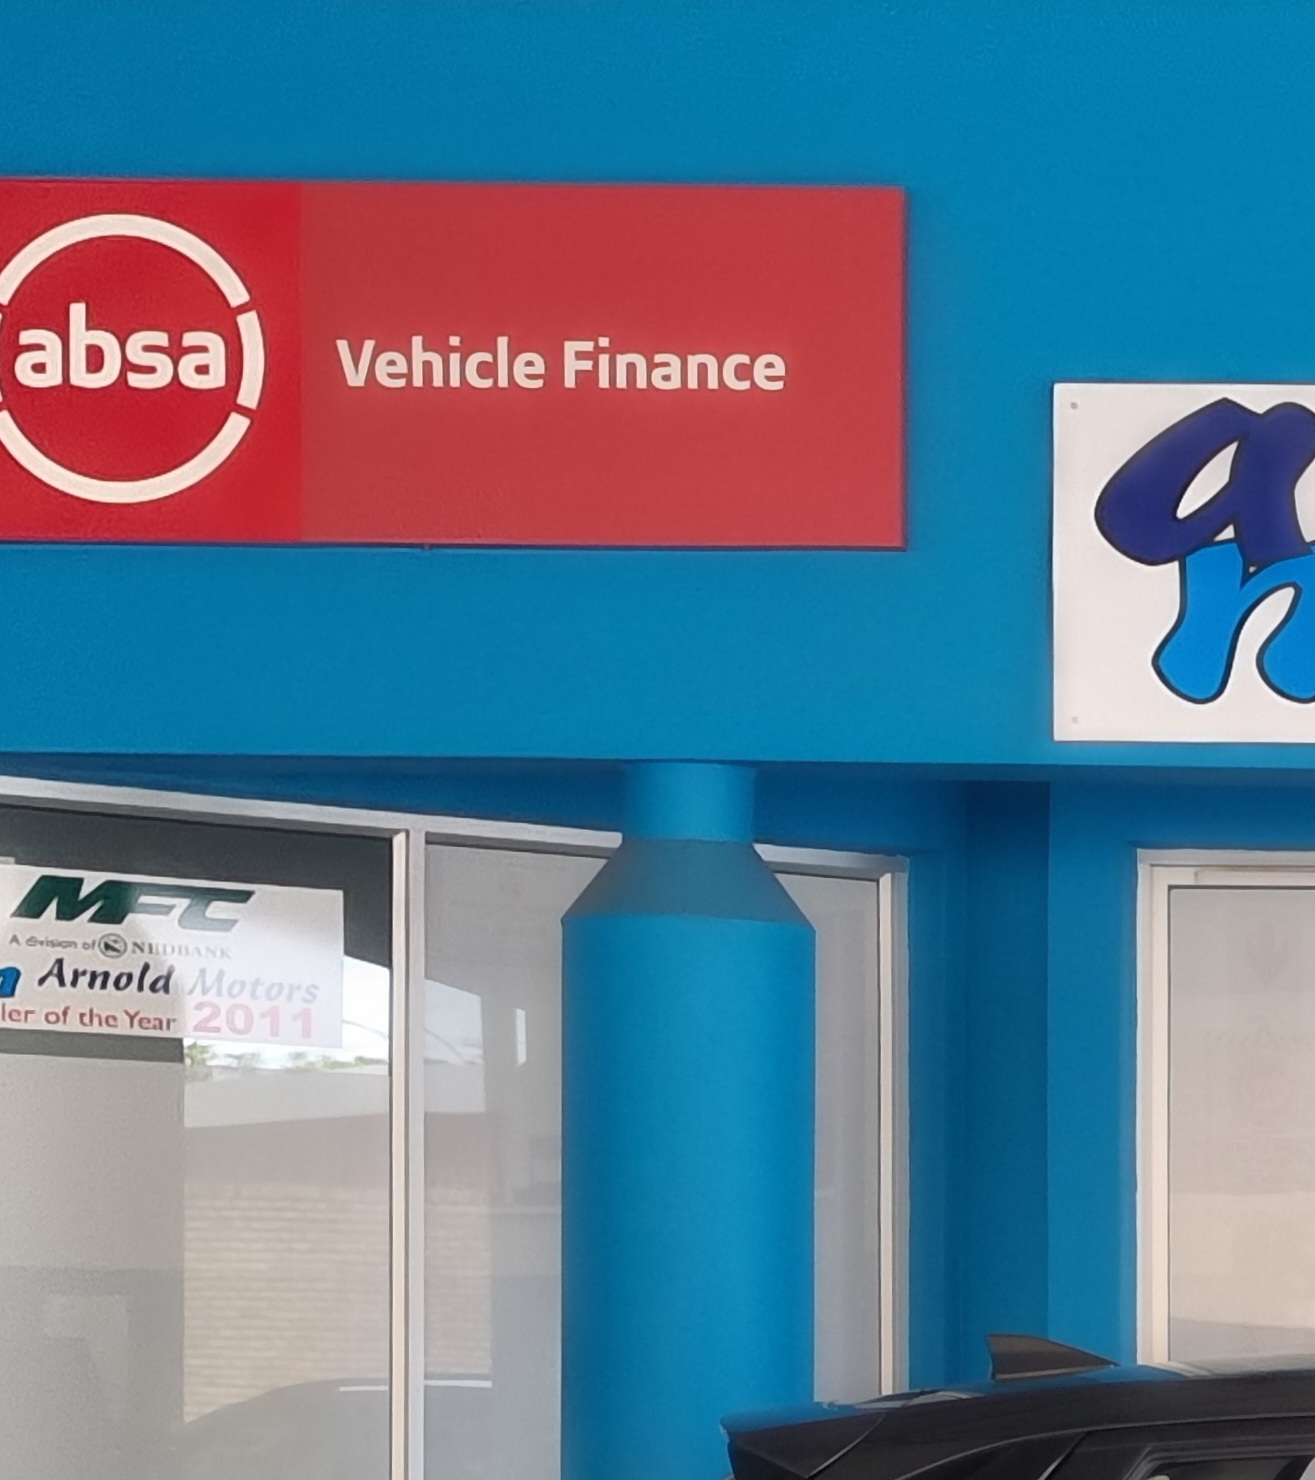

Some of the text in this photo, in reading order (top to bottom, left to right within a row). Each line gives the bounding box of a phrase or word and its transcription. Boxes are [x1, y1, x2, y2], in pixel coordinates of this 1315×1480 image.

[13, 302, 227, 390] absa
[336, 337, 787, 392] Vehicle Finance
[9, 874, 256, 933] MFC
[9, 933, 21, 947] A
[38, 957, 175, 996] Arnold
[187, 966, 320, 1004] Motors
[44, 1005, 71, 1026] of
[79, 1007, 118, 1029] the
[123, 1008, 178, 1033] Year
[192, 1001, 314, 1040] 2011
